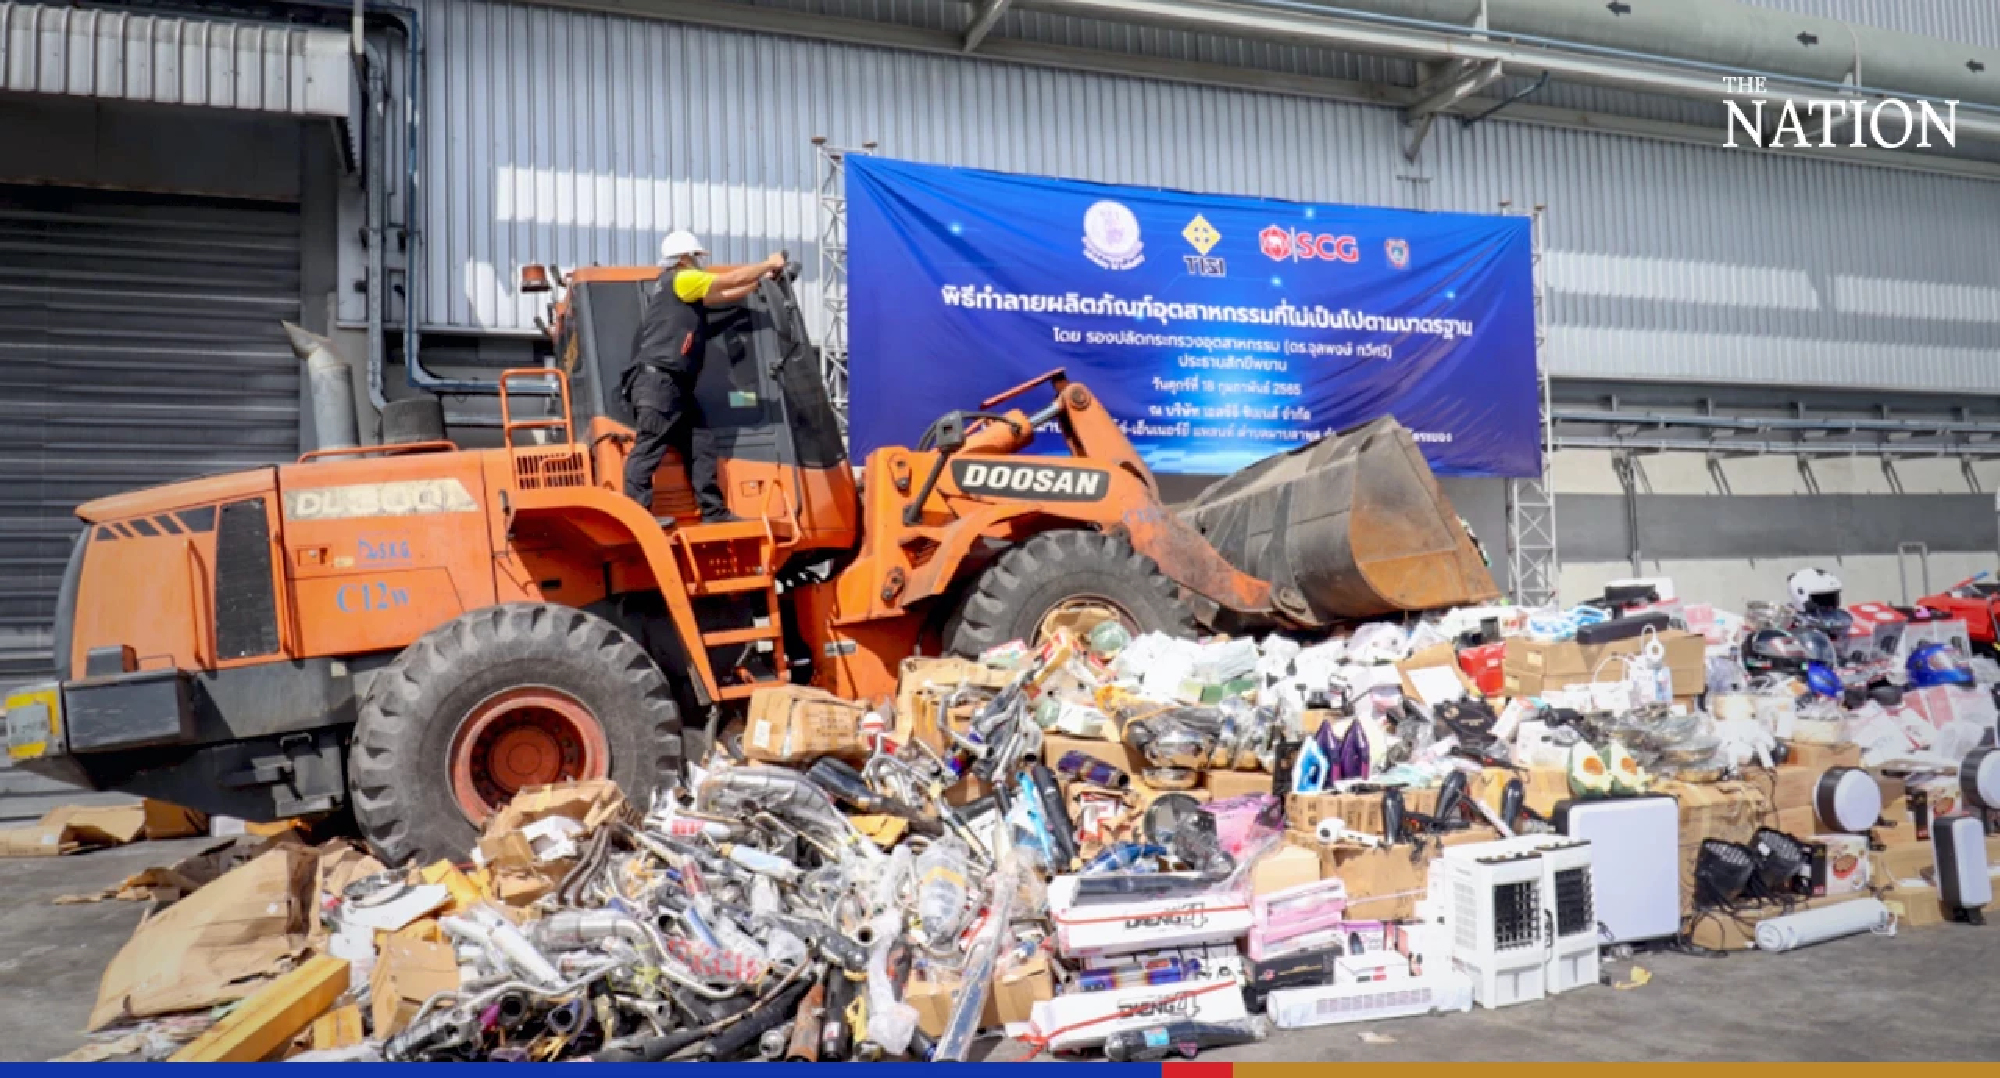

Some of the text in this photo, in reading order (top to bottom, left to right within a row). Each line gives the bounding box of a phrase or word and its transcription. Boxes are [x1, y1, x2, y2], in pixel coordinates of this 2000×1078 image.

[1296, 233, 1358, 263] SCG
[941, 284, 1472, 340] พิธีทำลายผลิตภัณฑ์อุตสาหกรรมที่ไม่เป็นไปตามมาตรฐาน
[1053, 327, 1081, 342] โดย
[962, 464, 1099, 495] DOOSAN
